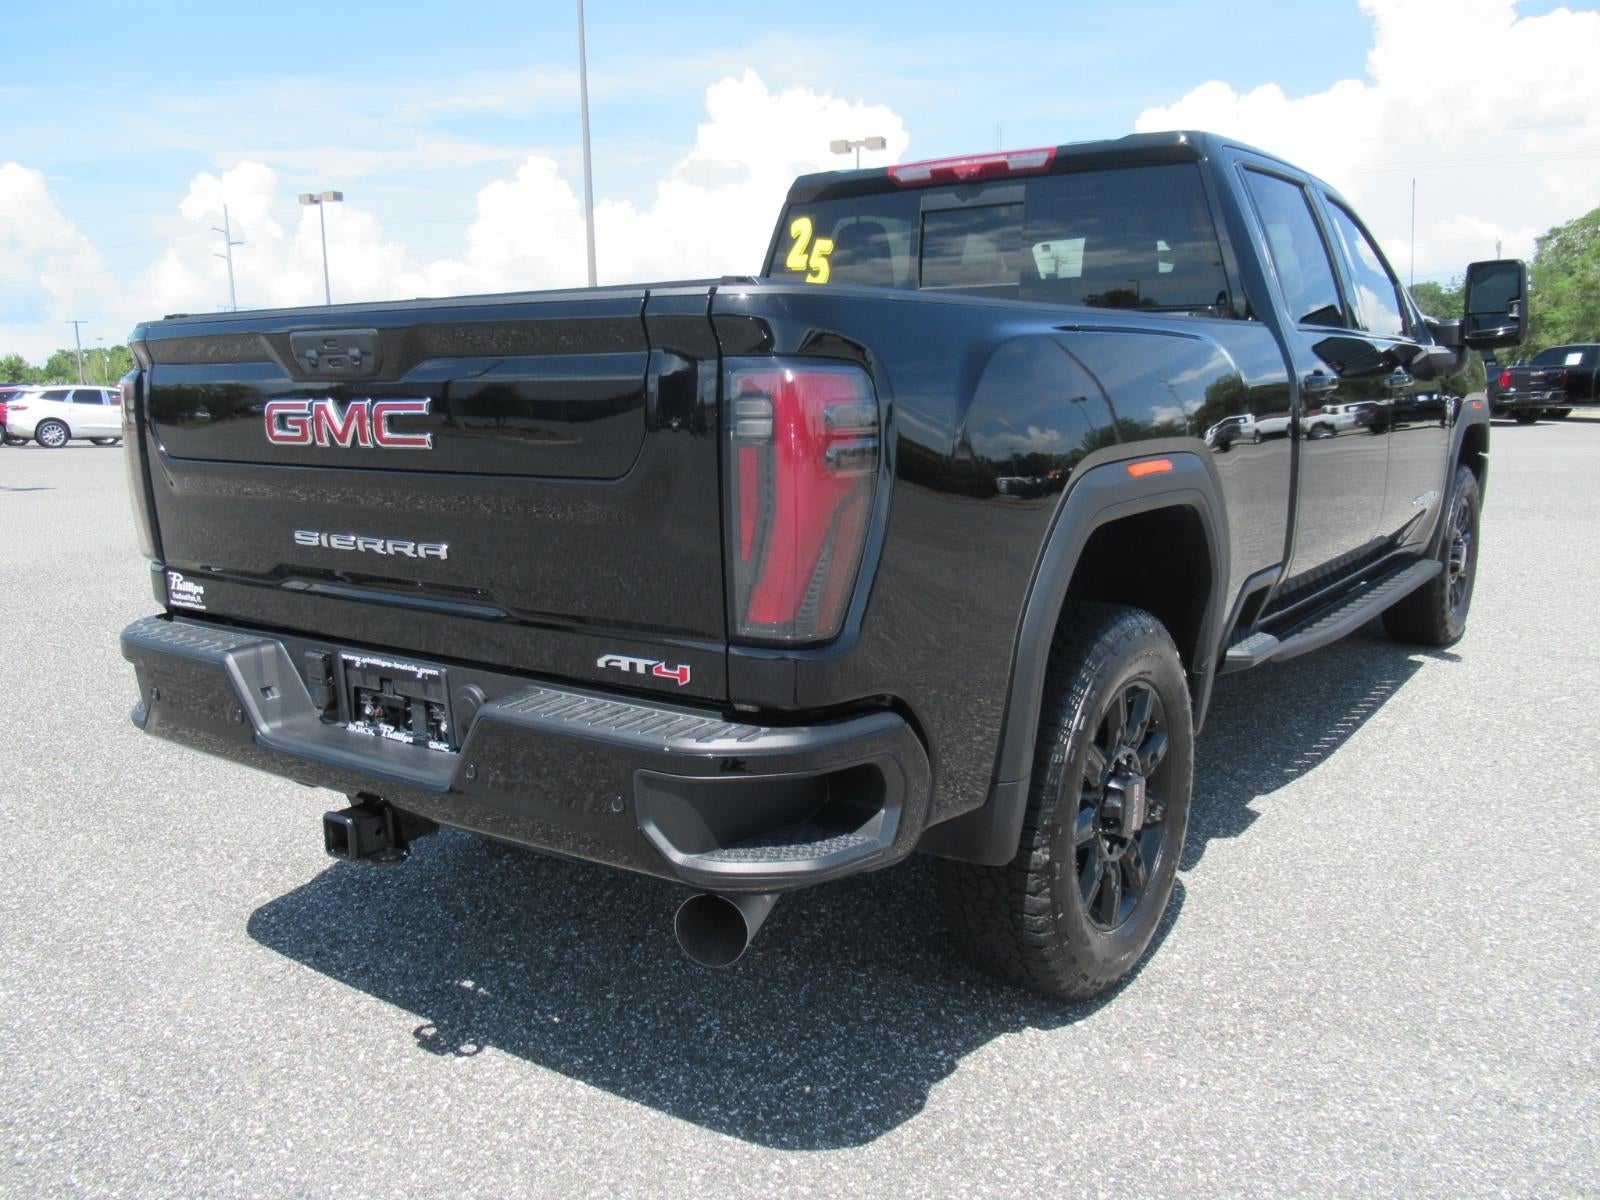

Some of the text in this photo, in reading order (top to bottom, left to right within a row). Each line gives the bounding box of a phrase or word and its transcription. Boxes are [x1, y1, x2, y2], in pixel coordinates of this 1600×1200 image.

[786, 216, 834, 284] 25
[265, 398, 433, 450] GMC
[294, 530, 448, 560] SIERRA
[168, 571, 205, 595] Phillips
[341, 653, 439, 676] www.phillips-buick.com
[597, 654, 691, 686] AT4
[346, 722, 376, 737] BUICK
[379, 723, 414, 743] Phillips
[428, 740, 450, 752] GMC
